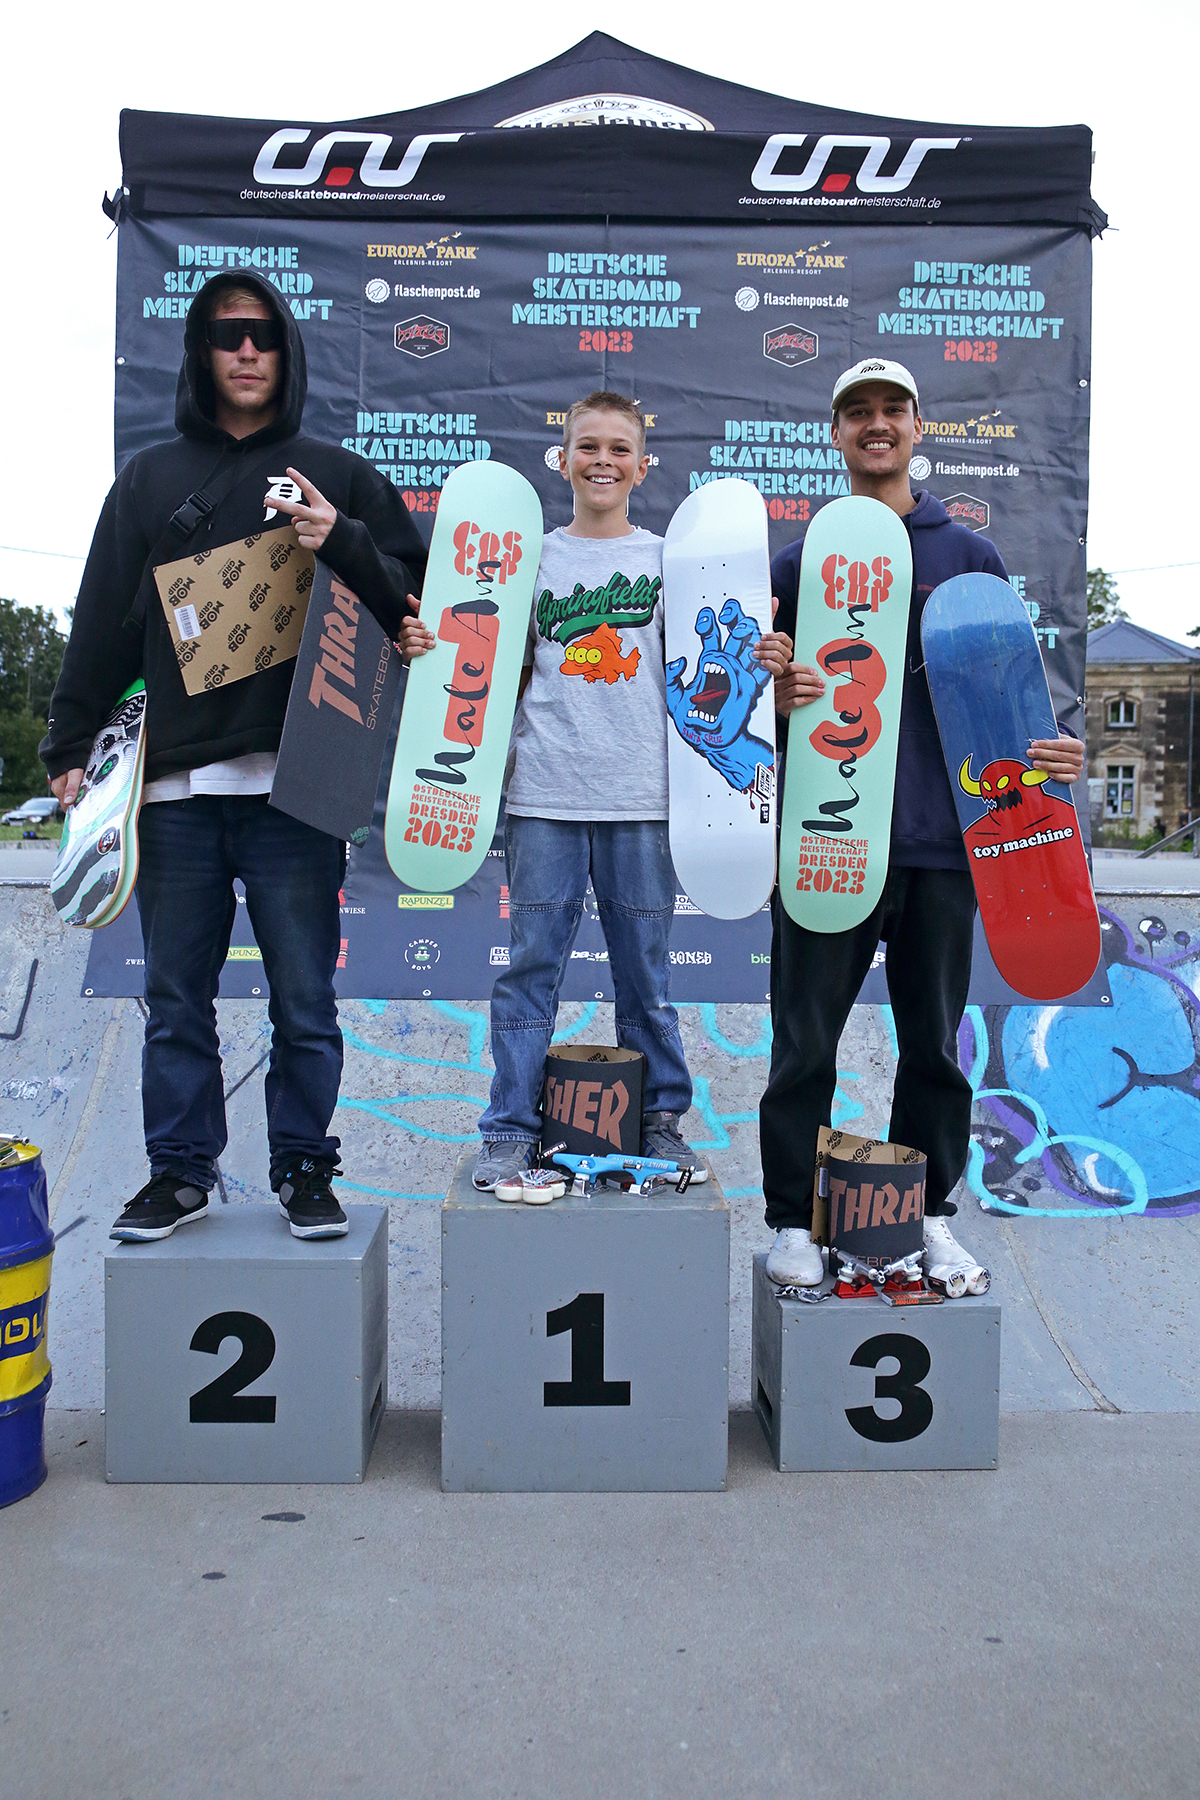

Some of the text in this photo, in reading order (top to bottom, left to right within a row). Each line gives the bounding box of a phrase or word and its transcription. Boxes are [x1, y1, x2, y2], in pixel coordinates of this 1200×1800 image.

[239, 189, 446, 202] deutscheskateboardmeisterschaft.de
[738, 196, 941, 209] deutscheskateboardmeisterschaft.de
[178, 244, 299, 269] DEUTSCHE
[367, 244, 477, 260] EUROPA PARK
[736, 252, 845, 269] EUROPA PARK
[548, 252, 667, 276] DEUTSCHE
[914, 261, 1031, 287] DEUTSCHE
[163, 270, 314, 294] SKAARD
[532, 277, 682, 302] SKATEBOARD
[394, 284, 480, 301] flaschenpost.de
[763, 292, 849, 309] flaschenpost.de
[898, 287, 1046, 312] SKATEBOARD
[512, 303, 702, 329] MEISTERSCHAFT
[878, 312, 1065, 340] MEISTERSCHAFT
[578, 330, 634, 353] 2023
[944, 340, 998, 363] 2023
[356, 411, 478, 436] DEUTSCHE
[922, 421, 1016, 438] UROPA PARK
[935, 437, 993, 445] ERLEBNIS-RESORT
[935, 461, 1020, 479] flaschenpost.de
[401, 490, 441, 513] 023
[244, 534, 262, 549] OB
[193, 550, 212, 566] OB
[270, 543, 285, 561] GRIP
[270, 543, 296, 572] MOB
[221, 560, 236, 578] GRIP
[222, 559, 247, 590] MOB
[295, 567, 311, 584] GRIP
[168, 577, 184, 596] GRIP
[168, 576, 196, 607] MOB
[248, 583, 262, 601] GRIP
[249, 582, 272, 612] MOB
[537, 571, 662, 643] Springfield
[198, 601, 213, 619] GRIP
[199, 600, 225, 630] MOB
[274, 605, 287, 623] GRIP
[274, 604, 297, 634] MOB
[227, 623, 241, 642] GRIP
[228, 622, 252, 653] MOB
[254, 645, 268, 663] GRIP
[308, 579, 364, 726] THRA
[204, 664, 219, 682] GRIP
[682, 727, 724, 745] SANTA CRUZ
[411, 793, 480, 812] MEISTERSCHAFT
[413, 784, 481, 804] OSTDEUTSCHE
[409, 802, 479, 827] DRESDEN
[403, 817, 476, 853] 2023
[800, 835, 869, 848] OSTDEUTSCHE
[972, 826, 1074, 859] toy machine
[800, 845, 868, 856] MEISTERSCHAFT
[799, 853, 868, 870] DRESDEN
[796, 867, 866, 895] 2023
[400, 896, 452, 907] RAPUNZEL
[408, 938, 439, 949] CAMPER
[647, 1162, 669, 1170] BUILT
[830, 1176, 926, 1243] THRA
[544, 1293, 631, 1407] 1
[189, 1310, 277, 1424] 2
[845, 1333, 933, 1443] 3
